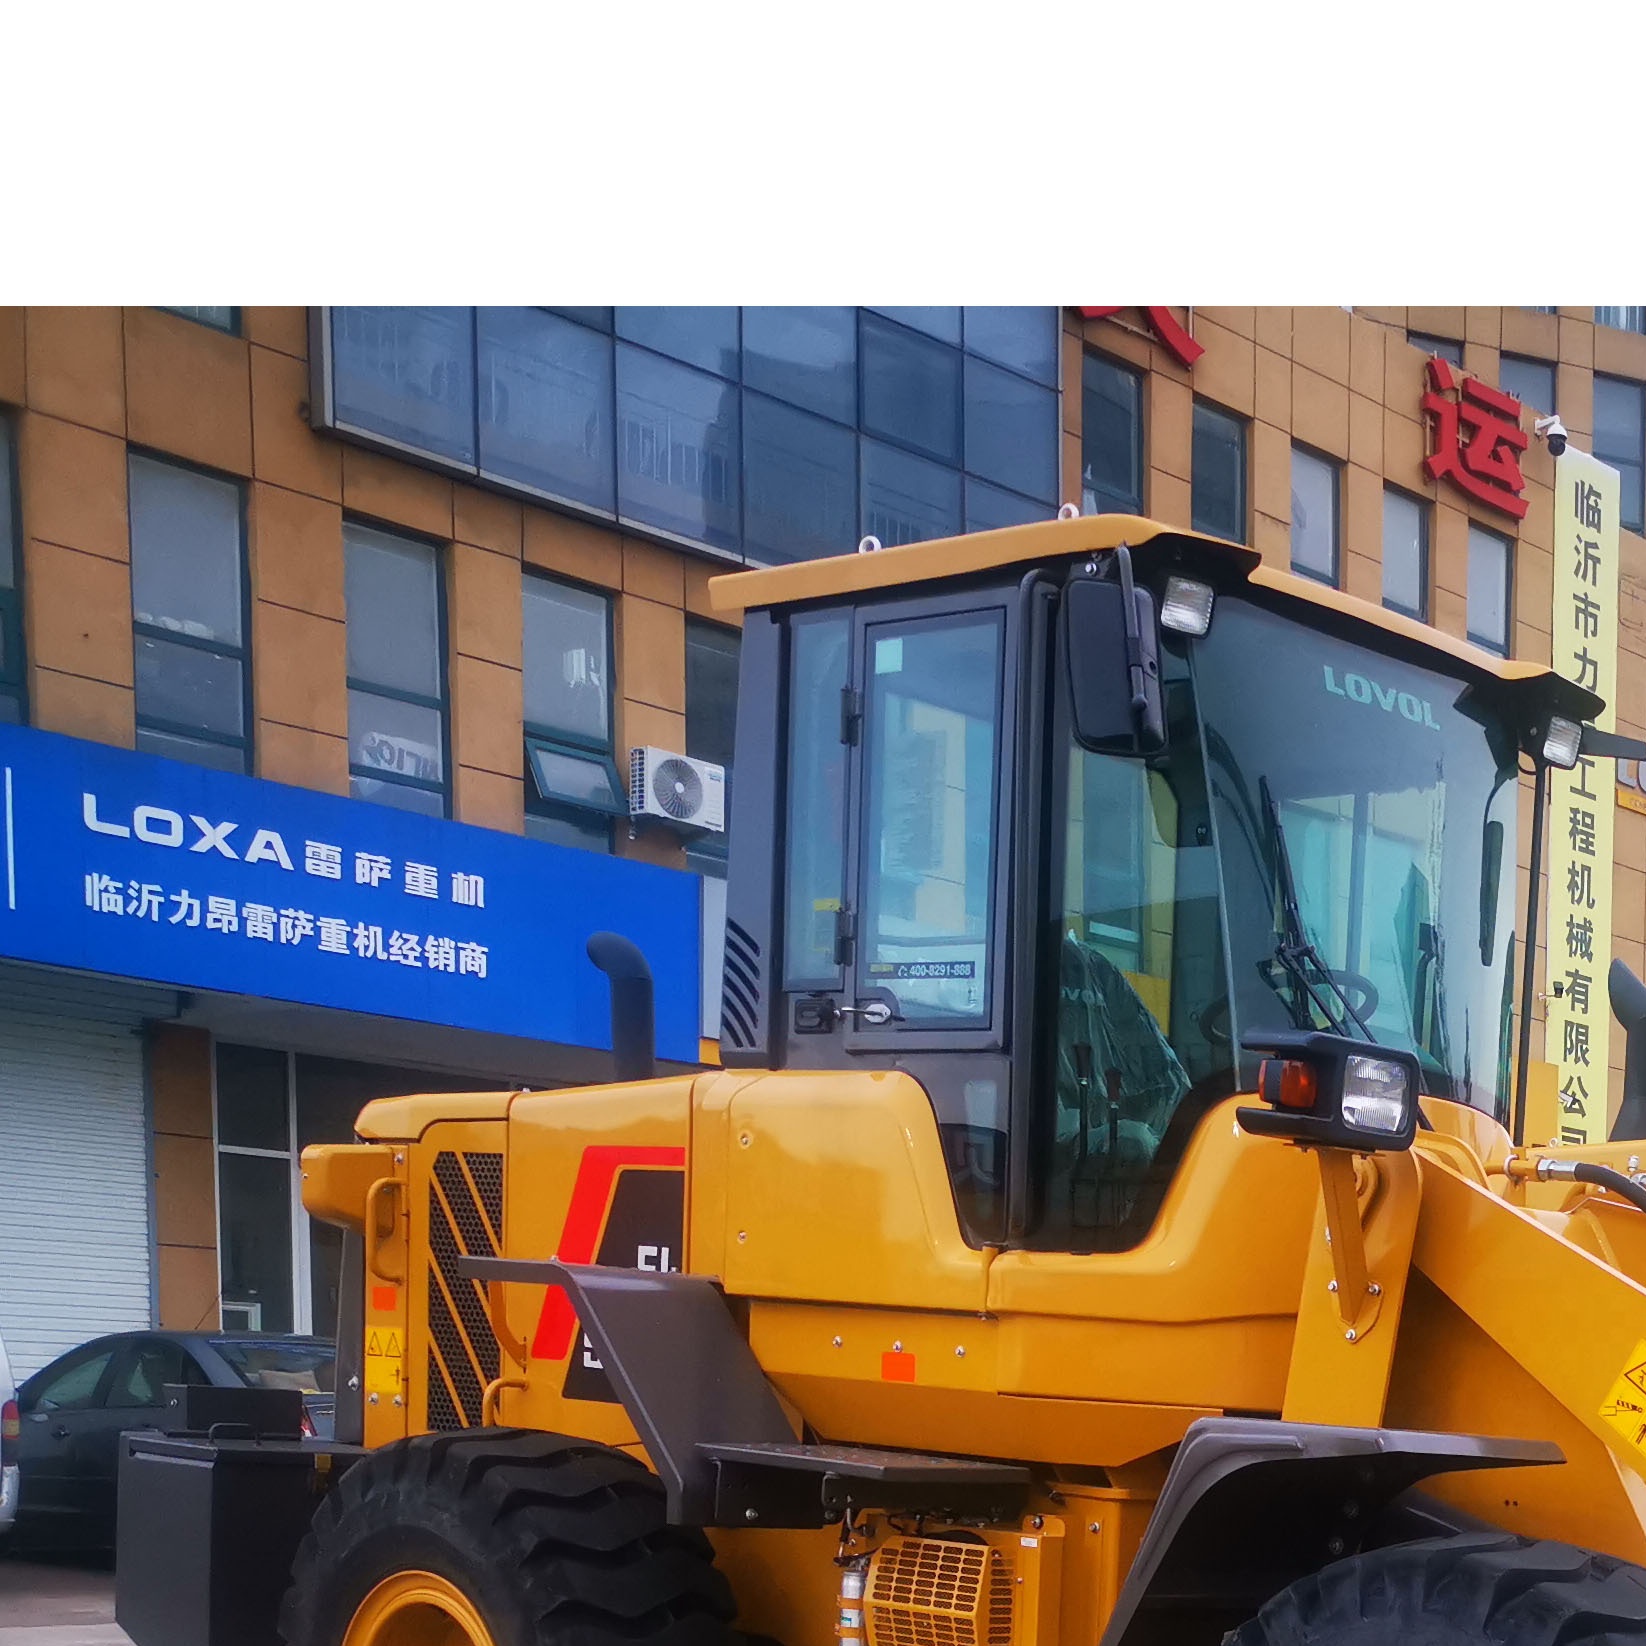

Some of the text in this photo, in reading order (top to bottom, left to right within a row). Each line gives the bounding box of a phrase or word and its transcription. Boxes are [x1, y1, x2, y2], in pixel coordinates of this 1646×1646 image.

[1323, 664, 1441, 731] LOVOL
[82, 792, 486, 908] LOXA 雷萨重机
[1561, 479, 1602, 1143] 临沂市力工程机械有限公司
[84, 871, 489, 979] 临沂力昂雷萨重机经销商
